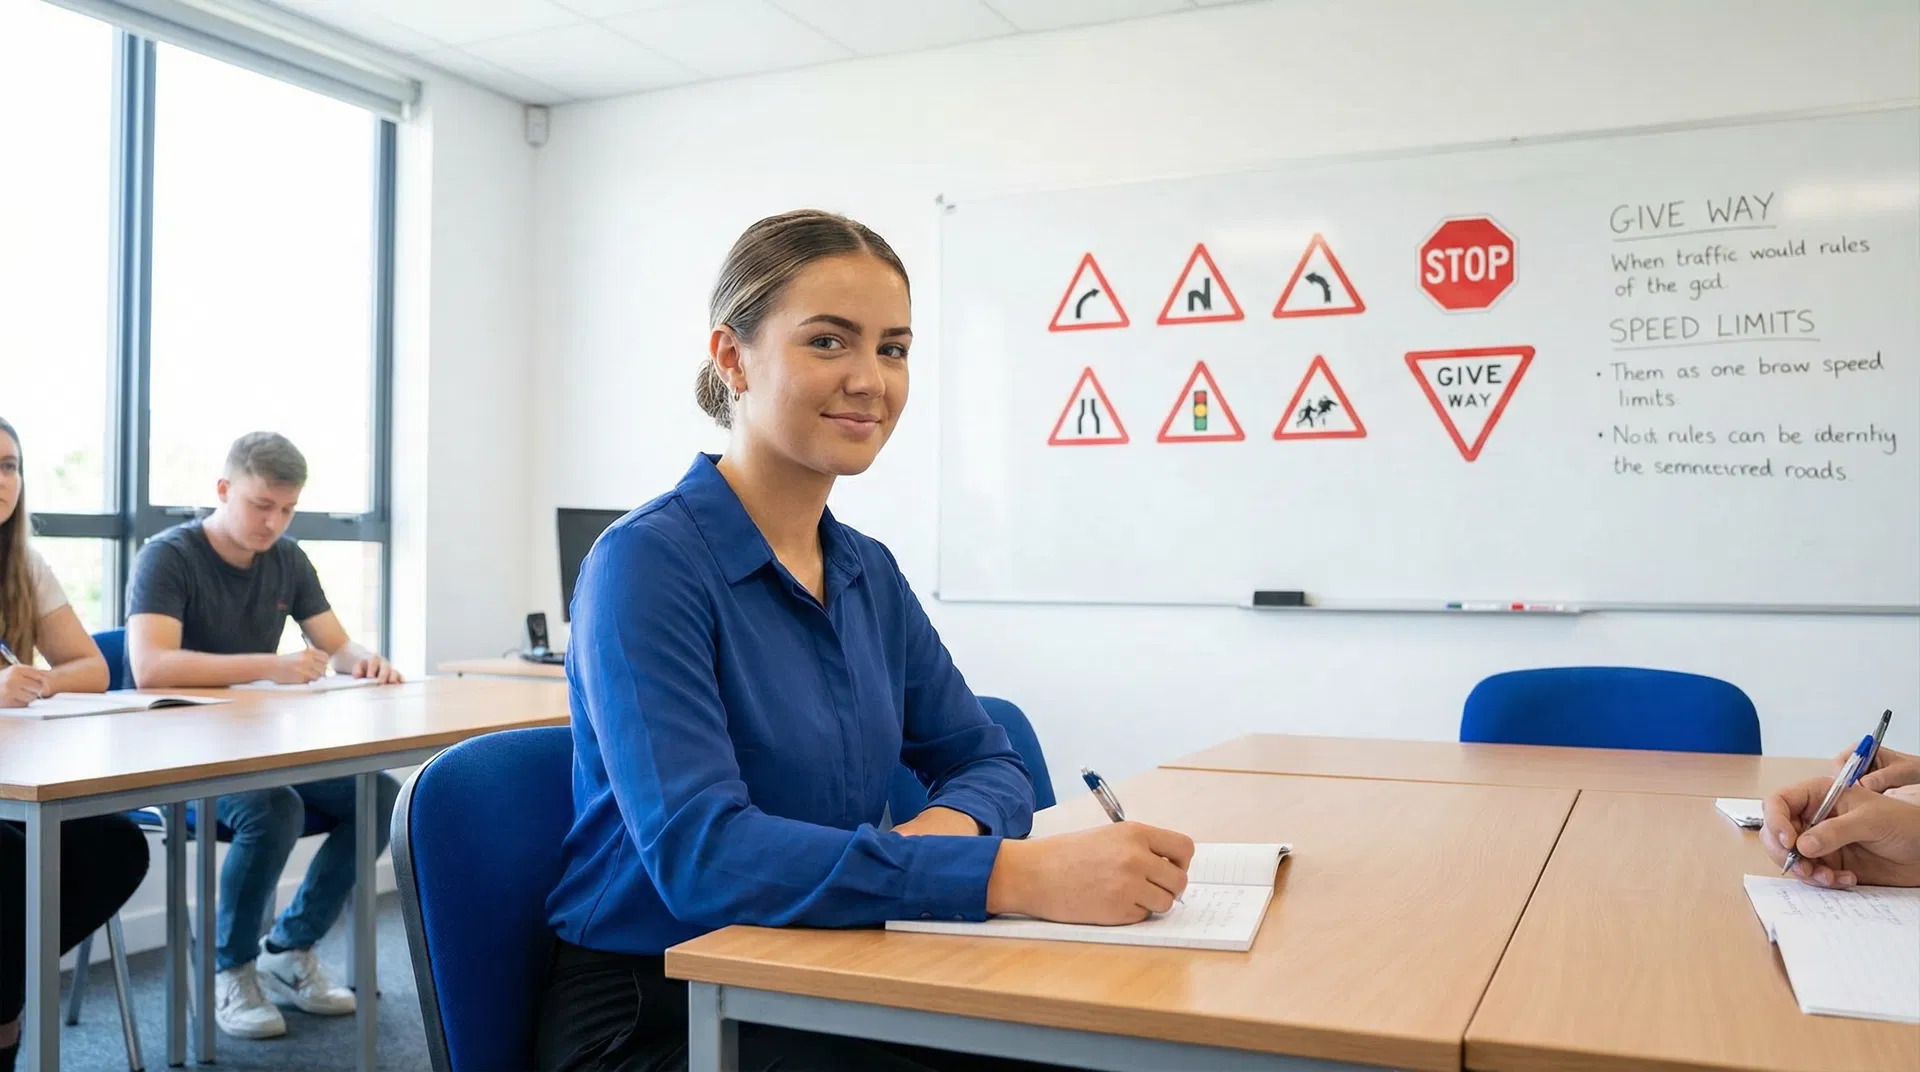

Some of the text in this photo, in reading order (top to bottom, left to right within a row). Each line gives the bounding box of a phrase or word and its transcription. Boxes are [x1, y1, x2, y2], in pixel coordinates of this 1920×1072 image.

[1609, 192, 1774, 234] GIVE WAY
[1424, 245, 1510, 284] STOP
[1611, 235, 1870, 272] When traffic would rules
[1615, 276, 1635, 297] of
[1647, 277, 1677, 294] the
[1609, 309, 1815, 343] SPEED LIMITS
[1437, 364, 1502, 386] GIVE
[1610, 362, 1664, 381] Them
[1677, 366, 1700, 379] as
[1711, 364, 1745, 377] one
[1823, 350, 1884, 379] speed
[1448, 394, 1490, 407] WAY
[1619, 389, 1675, 407] limits
[1668, 424, 1716, 444] rules
[1728, 431, 1765, 444] can
[1778, 424, 1803, 444] be
[1614, 456, 1644, 475] the
[1785, 460, 1846, 481] roads
